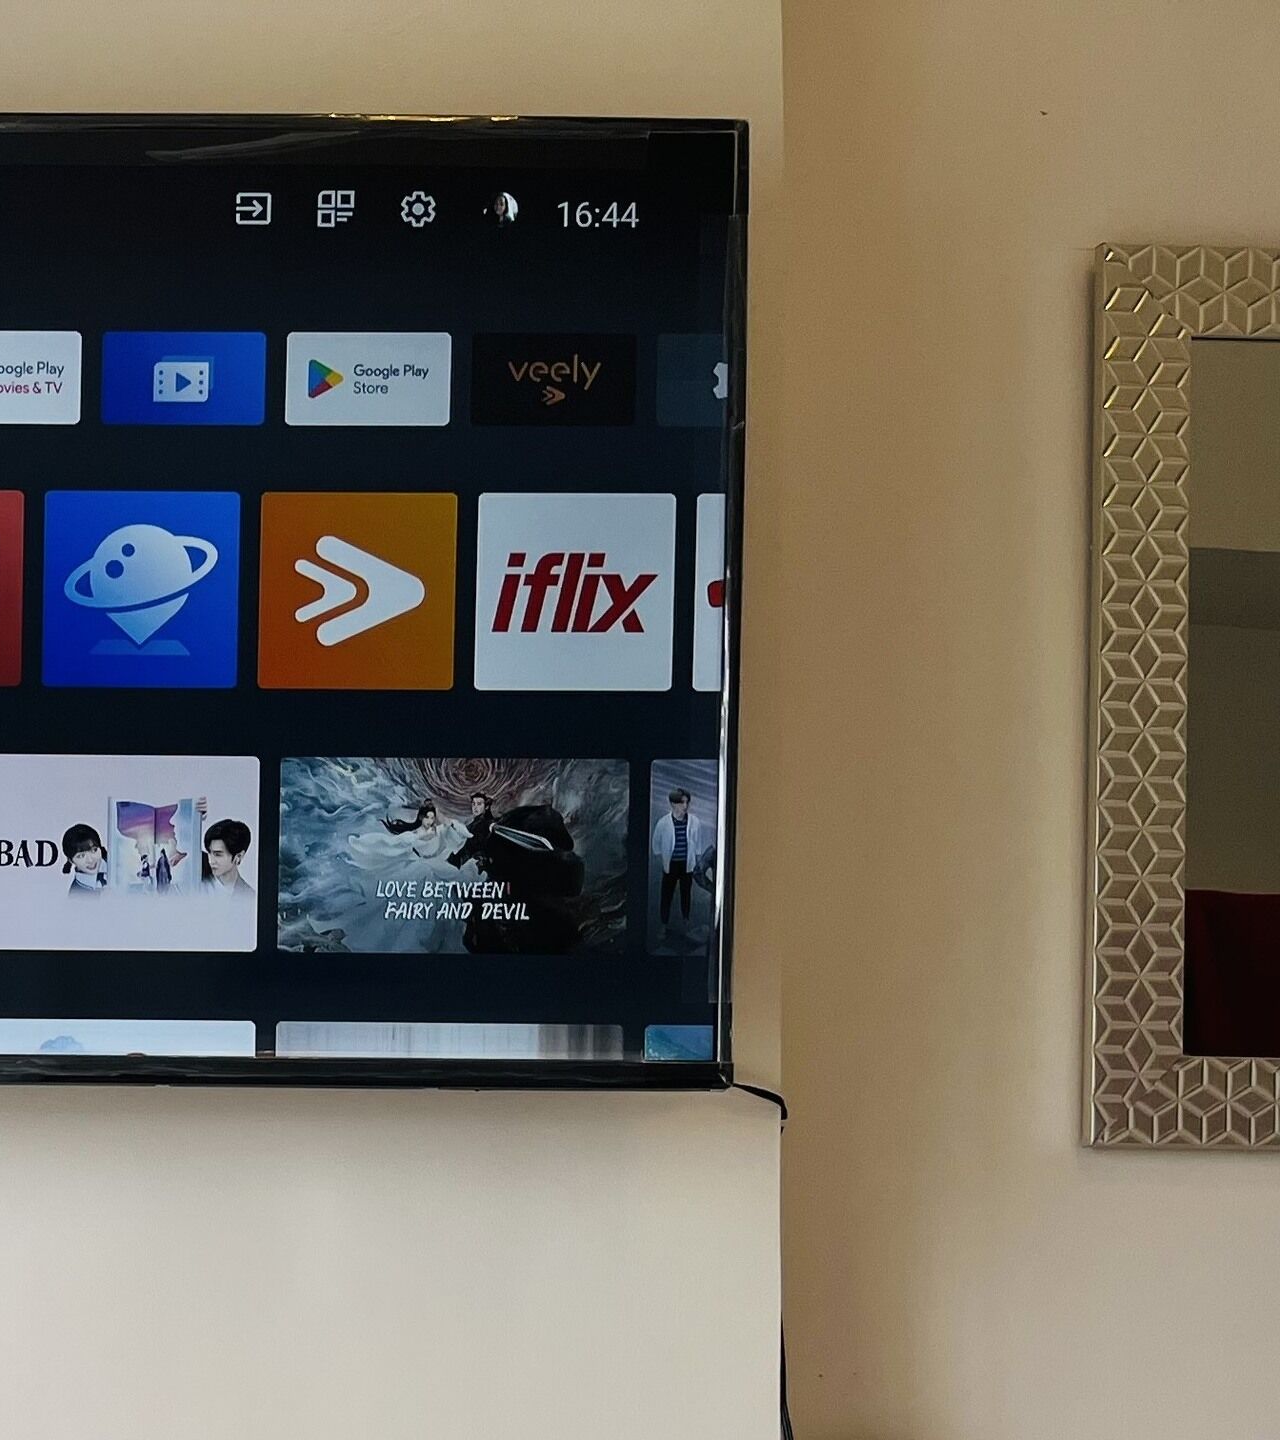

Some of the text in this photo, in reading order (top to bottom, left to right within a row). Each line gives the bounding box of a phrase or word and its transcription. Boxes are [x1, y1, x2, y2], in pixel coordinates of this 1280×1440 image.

[558, 202, 639, 228] 16:44
[35, 361, 65, 380] Play
[352, 364, 429, 381] Google Play
[508, 354, 602, 390] veely
[32, 382, 42, 395] &
[45, 381, 63, 395] TV
[353, 381, 388, 395] Store
[491, 552, 658, 633] iflix
[376, 881, 505, 899] LOVE BETWEEN
[384, 902, 530, 921] FAIRY AND DEVIL
